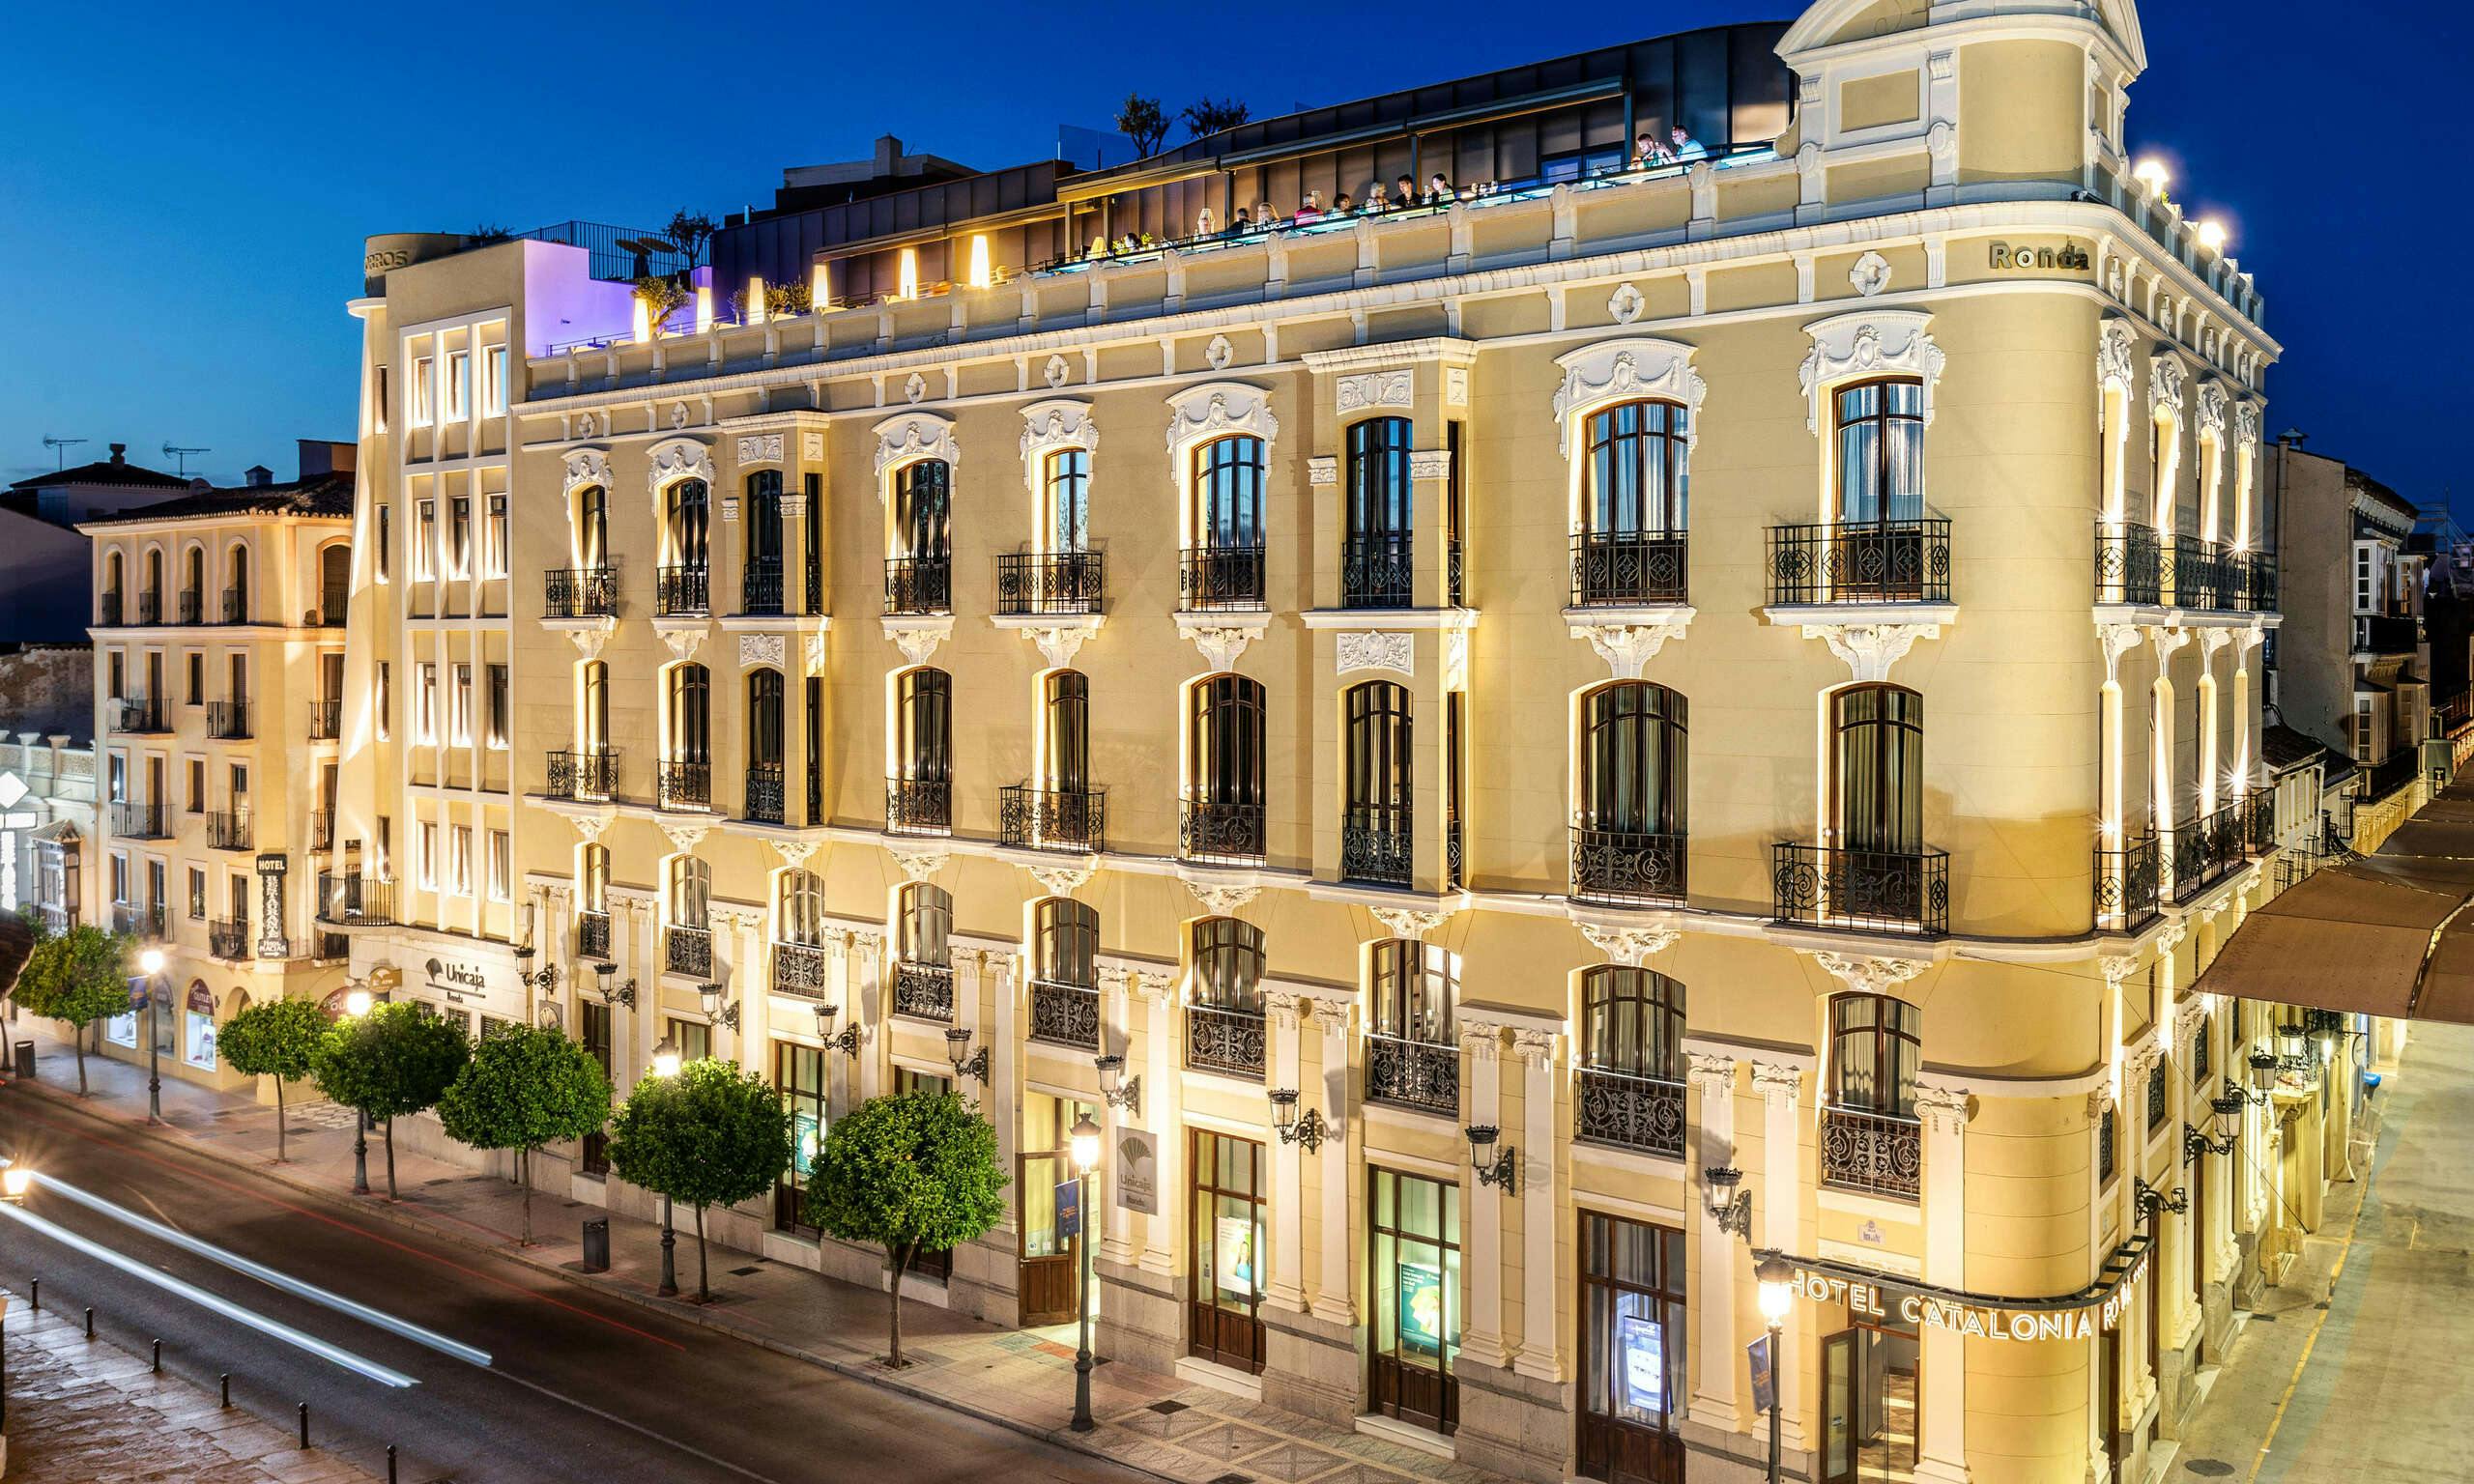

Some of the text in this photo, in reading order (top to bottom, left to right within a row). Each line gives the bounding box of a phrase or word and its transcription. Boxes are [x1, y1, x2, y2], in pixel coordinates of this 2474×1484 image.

[1989, 241, 2089, 270] Ronda
[258, 860, 285, 870] HOTEL
[446, 963, 485, 991] Unicaja
[1790, 1268, 1885, 1316] HOTEL
[1901, 1296, 2092, 1341] CATALONIA
